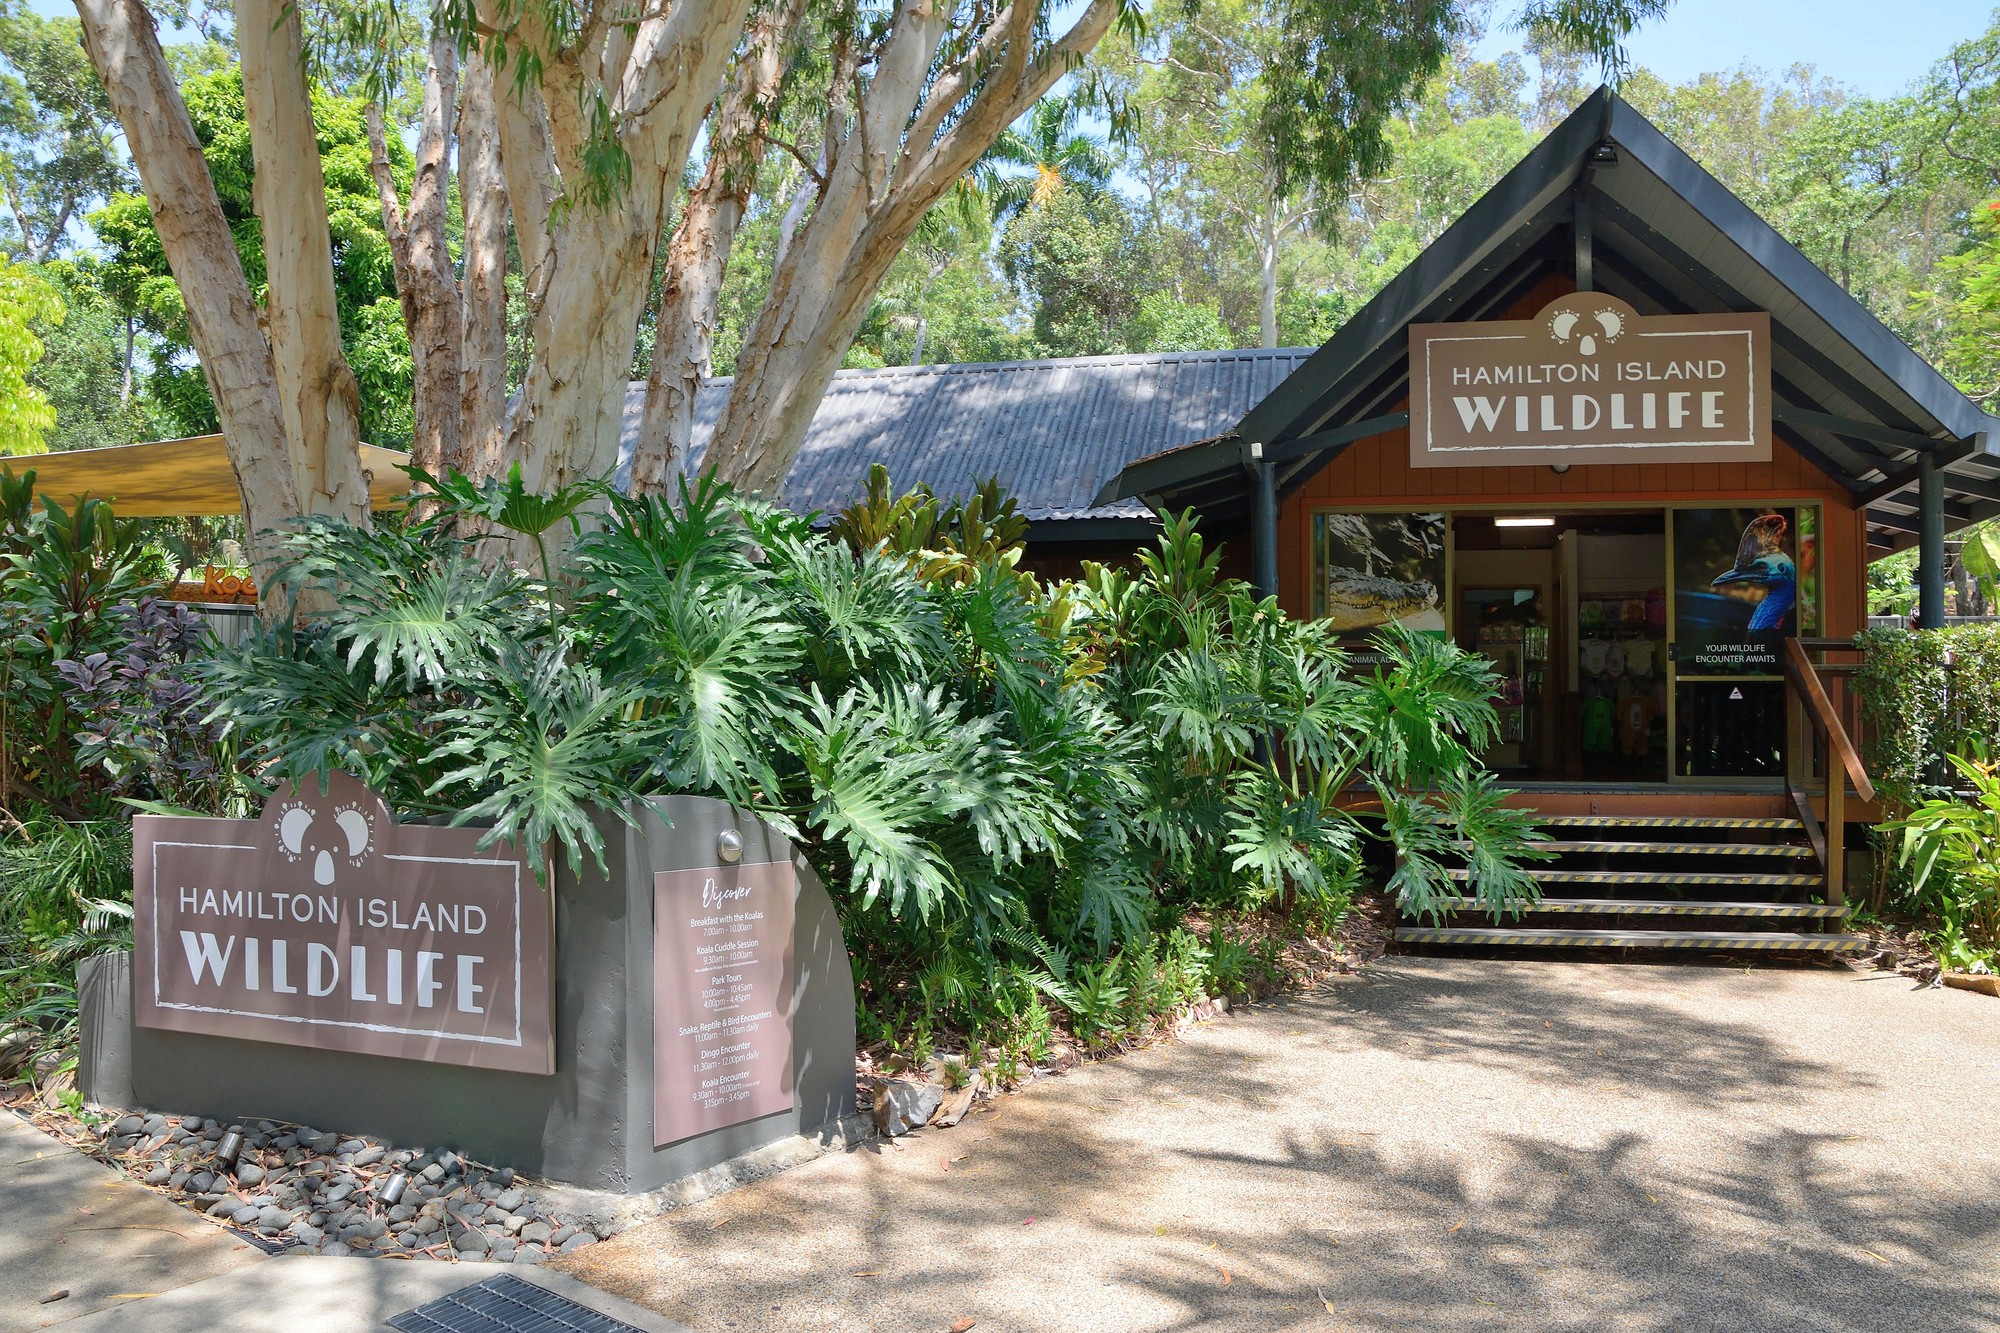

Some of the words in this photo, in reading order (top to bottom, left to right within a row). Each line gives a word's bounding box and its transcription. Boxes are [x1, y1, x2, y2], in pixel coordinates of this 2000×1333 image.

[1453, 363, 1599, 385] HAMILTON
[1617, 360, 1726, 381] ISLAND
[1452, 391, 1725, 434] WILDLIFE
[203, 565, 258, 596] Koa
[1705, 644, 1728, 652] YOUR
[1729, 644, 1765, 652] WILDLIFE
[1348, 656, 1377, 664] ANIMAL
[1696, 655, 1744, 663] ENCOUNTER
[1745, 655, 1776, 663] AWAITS
[702, 878, 751, 909] Discover
[180, 887, 338, 924] HAMILTON
[358, 898, 487, 935] ISLAND
[691, 916, 719, 928] Breakfast
[719, 914, 734, 924] with
[734, 913, 744, 922] the
[745, 910, 764, 920] Koalas
[703, 926, 725, 937] 7.00am
[729, 923, 753, 933] 10.00am
[696, 945, 714, 955] Koala
[714, 942, 736, 953] Cuddle
[737, 939, 759, 950] Session
[703, 954, 725, 965] 9.30am
[729, 951, 753, 961] 10.00am
[179, 930, 485, 1014] WILDLIFE
[712, 976, 725, 985] Park
[726, 974, 742, 982] Tours
[702, 988, 726, 999] 10.00am
[730, 983, 753, 994] 10.45am
[703, 998, 726, 1009] 4.00pm
[730, 993, 752, 1004] 4.45pm
[679, 1025, 700, 1037] Snake,
[700, 1019, 721, 1033] Reptile
[722, 1019, 728, 1027] &
[728, 1016, 740, 1026] Bird
[740, 1010, 772, 1023] Encounters
[695, 1031, 718, 1043] 11.00am
[723, 1026, 745, 1038] 11.30am
[746, 1022, 760, 1034] daily
[701, 1048, 720, 1060] Dingo
[720, 1041, 751, 1055] Encounter
[693, 1061, 717, 1073] 11.30am
[721, 1055, 745, 1067] 12.00pm
[746, 1050, 760, 1061] daily
[702, 1077, 719, 1089] Koala
[720, 1071, 750, 1084] Encounter
[692, 1089, 714, 1102] 9.30am
[719, 1082, 742, 1095] 10.00am
[703, 1096, 725, 1109] 3.15pm
[729, 1090, 750, 1103] 3.45pm
